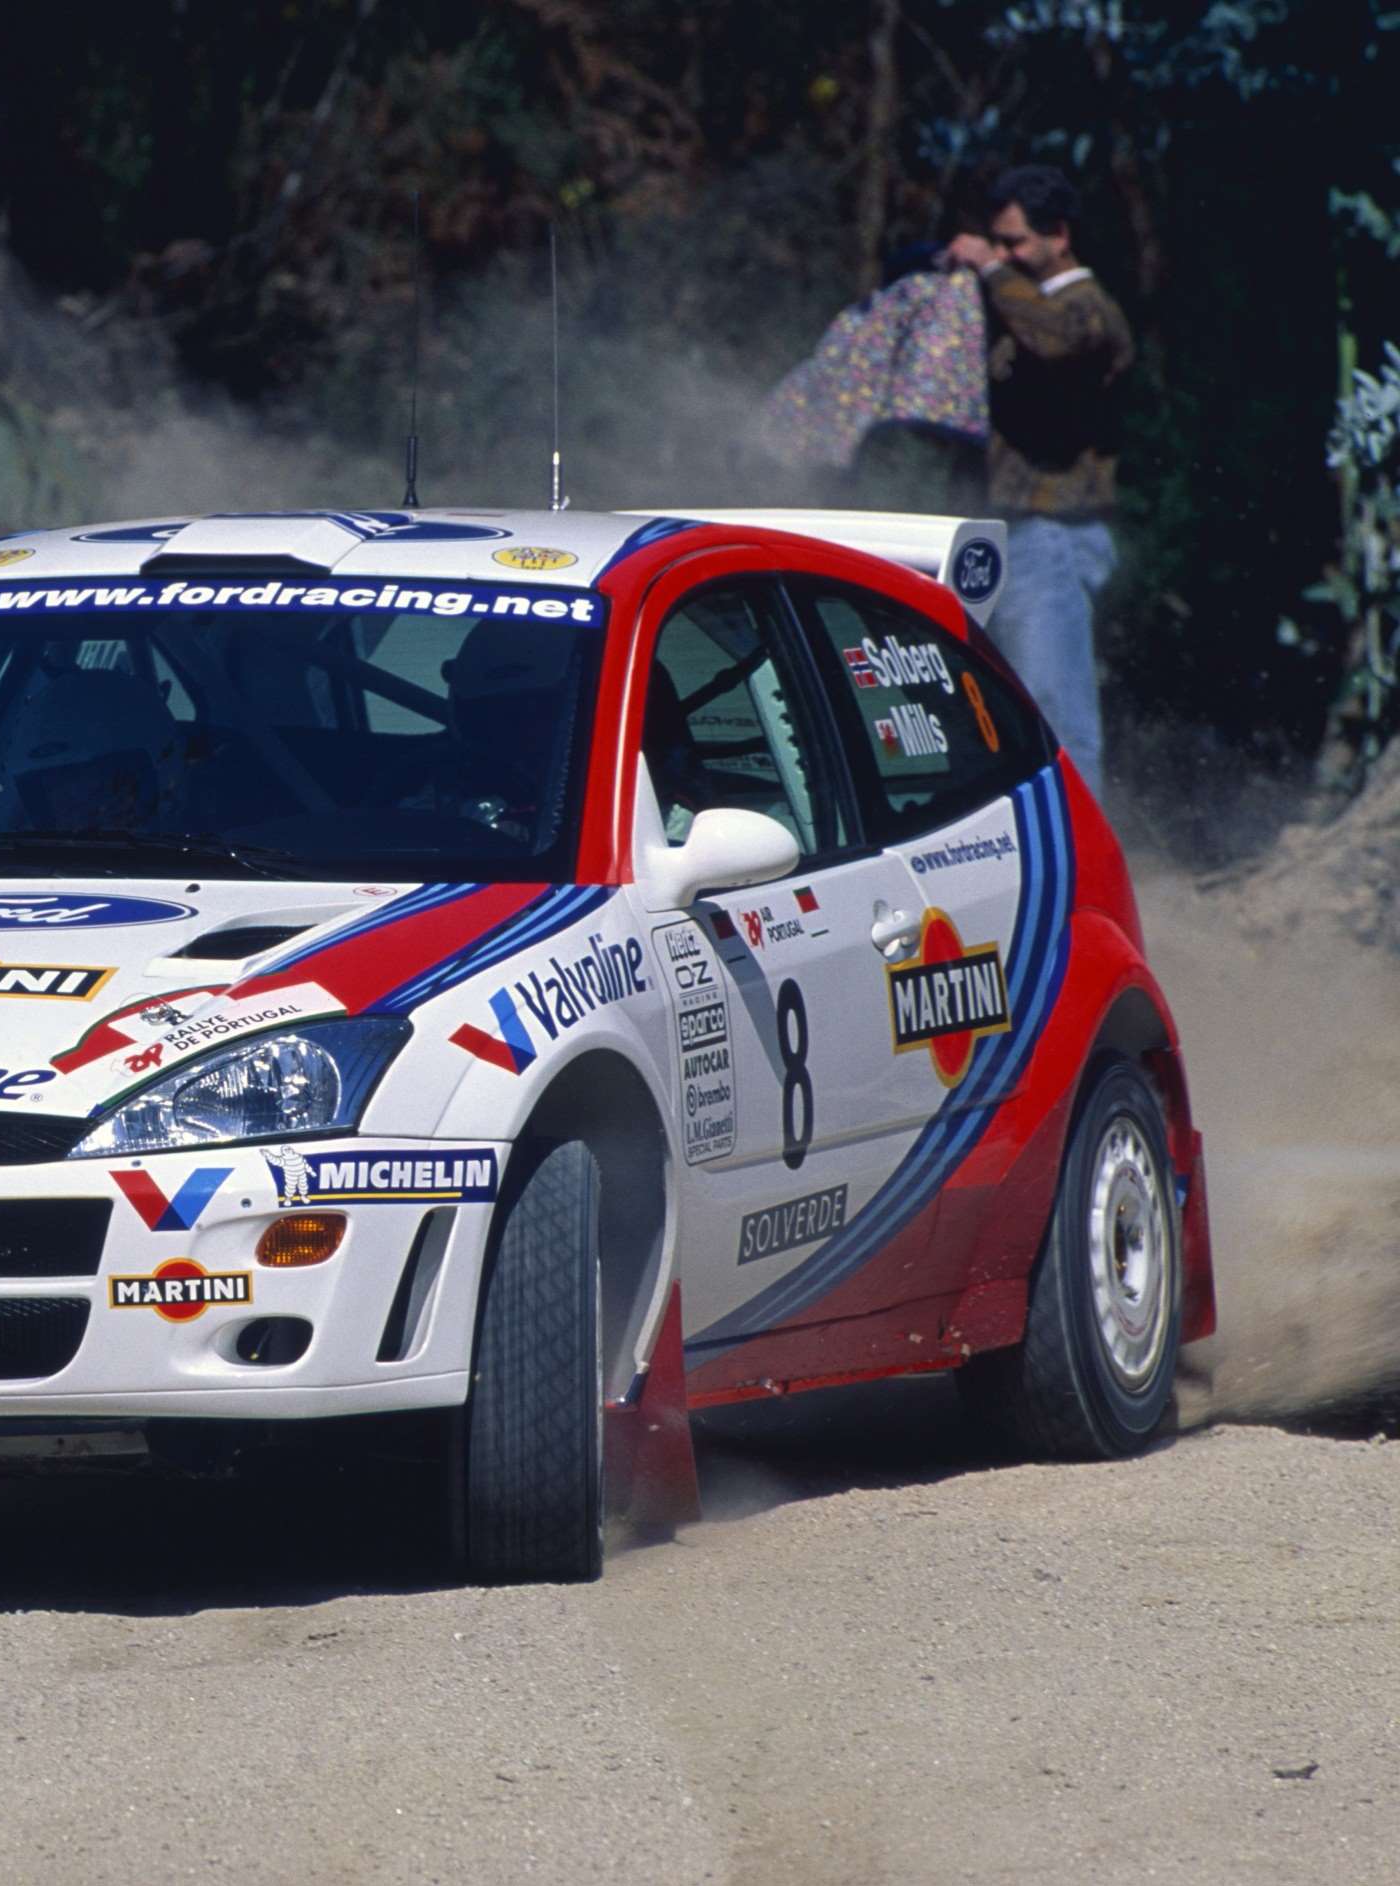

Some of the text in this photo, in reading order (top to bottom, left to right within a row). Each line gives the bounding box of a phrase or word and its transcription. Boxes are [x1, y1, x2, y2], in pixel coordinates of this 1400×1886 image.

[960, 546, 993, 591] Ford
[860, 635, 955, 695] Solberg
[890, 703, 949, 757] Mills
[767, 919, 805, 943] PORTUGAL
[514, 933, 647, 1041] Valvoline
[895, 961, 1003, 1035] MARTINI
[163, 1014, 228, 1044] RALLYE
[173, 1004, 303, 1051] DE PORTUGAL
[681, 1007, 725, 1047] sparco
[684, 1048, 730, 1080] AUTOCAR
[776, 978, 814, 1170] 8
[698, 1079, 731, 1108] brembo
[319, 1159, 492, 1190] MICHELIN
[744, 1189, 844, 1255] SOLVERDE
[117, 1276, 246, 1303] MARTINI
